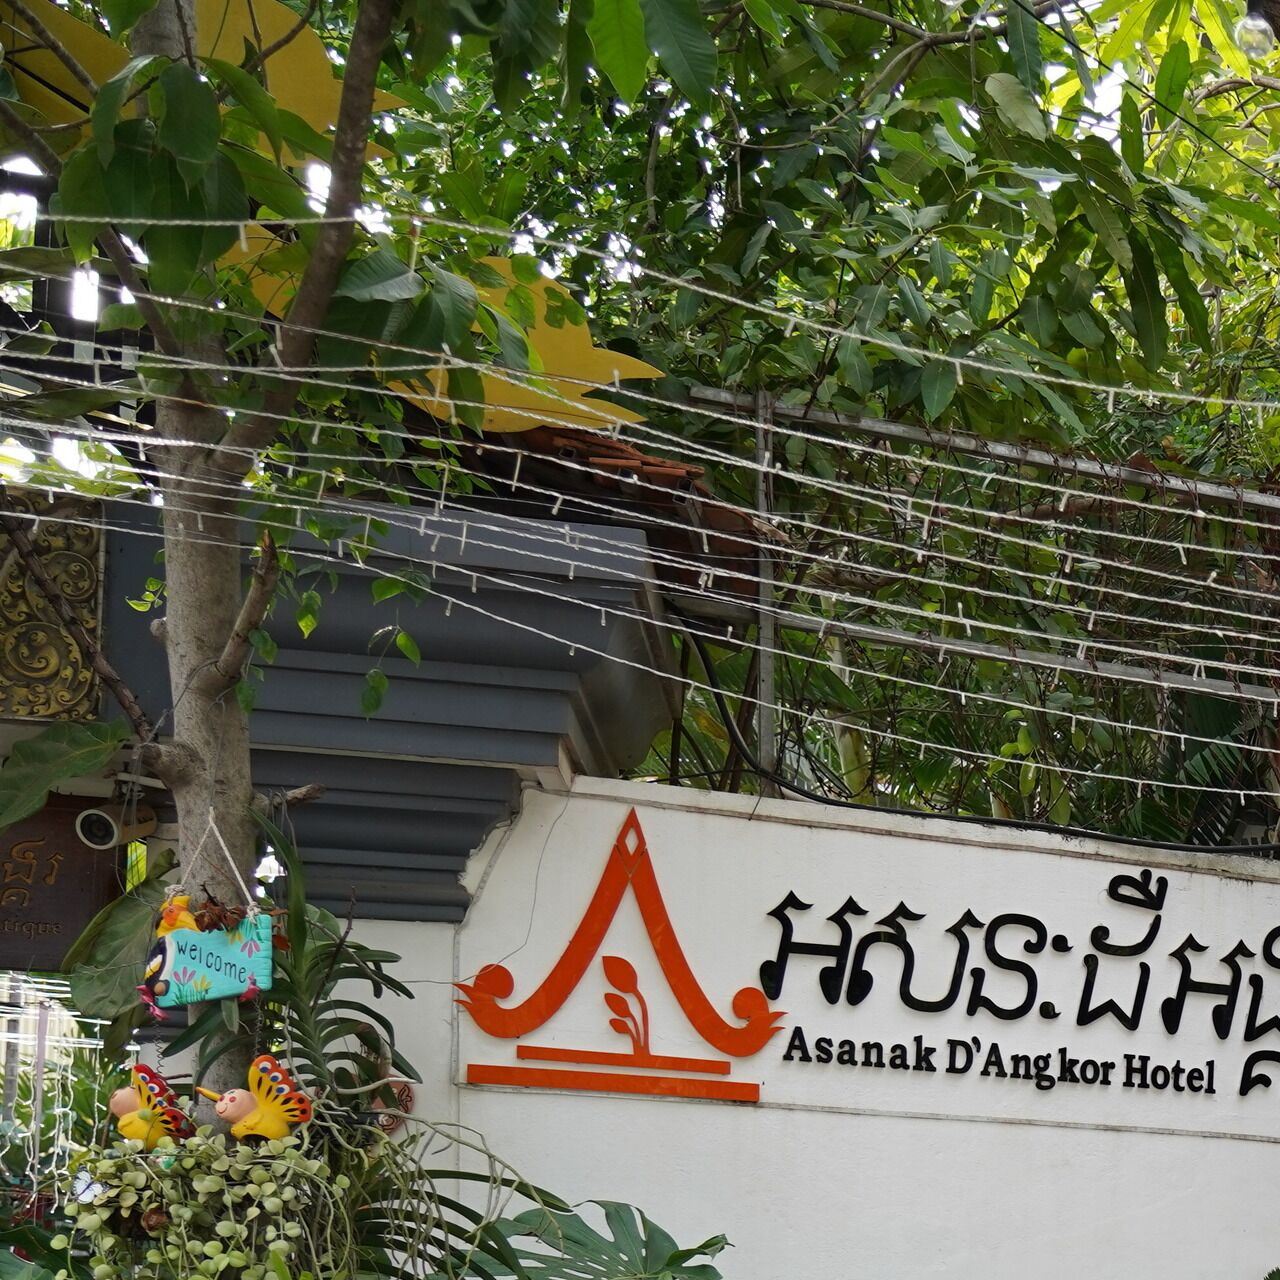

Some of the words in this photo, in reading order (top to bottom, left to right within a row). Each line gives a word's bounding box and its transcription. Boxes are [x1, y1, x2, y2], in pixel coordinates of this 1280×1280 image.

[782, 1025, 937, 1073] Asanak
[945, 1035, 1116, 1091] D'Angkor
[1121, 1053, 1217, 1095] Hotel
